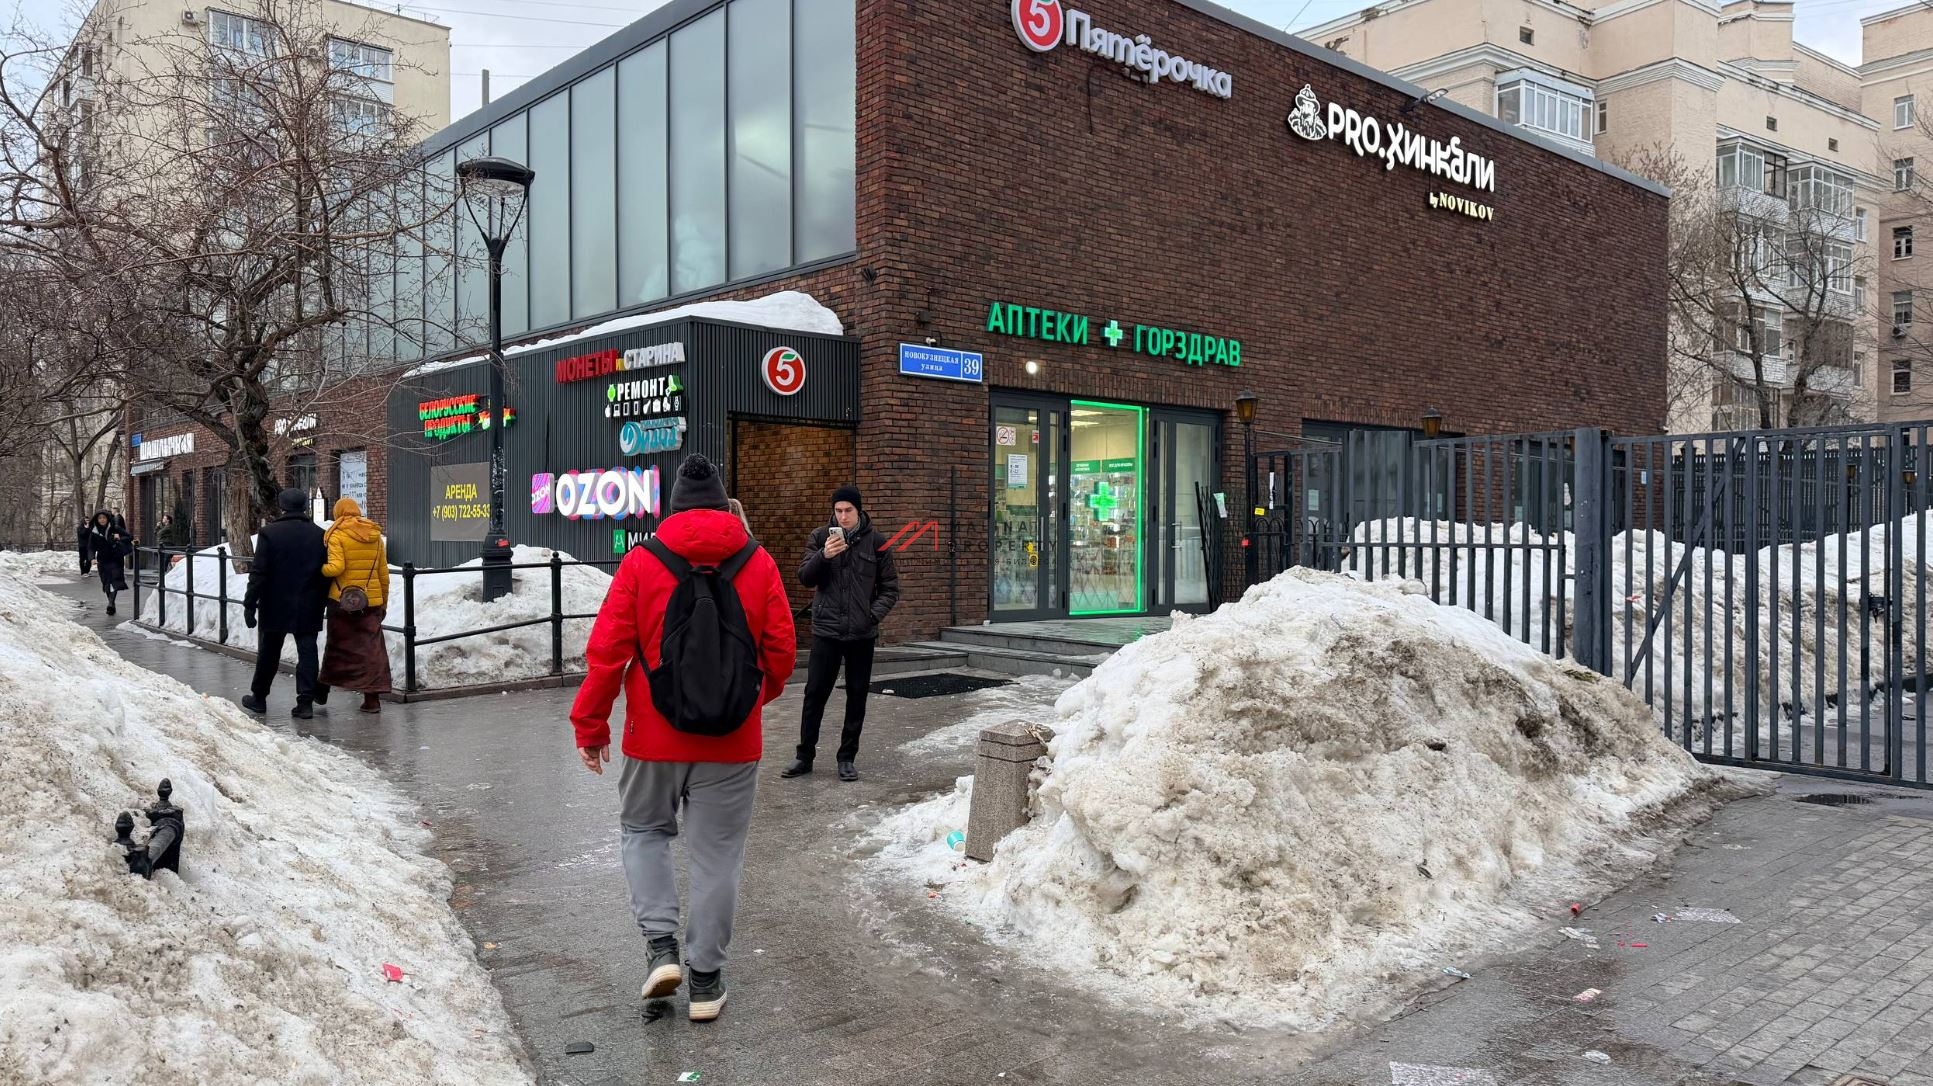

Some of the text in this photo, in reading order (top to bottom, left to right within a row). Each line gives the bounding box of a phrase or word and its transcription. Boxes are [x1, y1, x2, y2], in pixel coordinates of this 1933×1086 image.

[1065, 9, 1233, 99] Пятёрочка
[1439, 192, 1495, 222] NOVIKOV
[986, 302, 1243, 367] АПТЕКИ ГОРЗДРАВ
[556, 349, 617, 383] МОНЕТЫ
[624, 342, 686, 371] СТАРИНА
[775, 361, 796, 387] 5
[904, 350, 980, 376] НОВОКУЗНЕЦКАЯ 39
[921, 363, 943, 371] улица
[617, 377, 666, 402] РЕМОНТ
[419, 394, 477, 420] БЕЛОРУССКИЕ
[424, 414, 472, 440] ПРОДУКТЫ
[445, 483, 477, 501] АРЕНДА
[556, 469, 652, 517] OZON
[432, 506, 441, 519] +7
[441, 504, 458, 522] (903)
